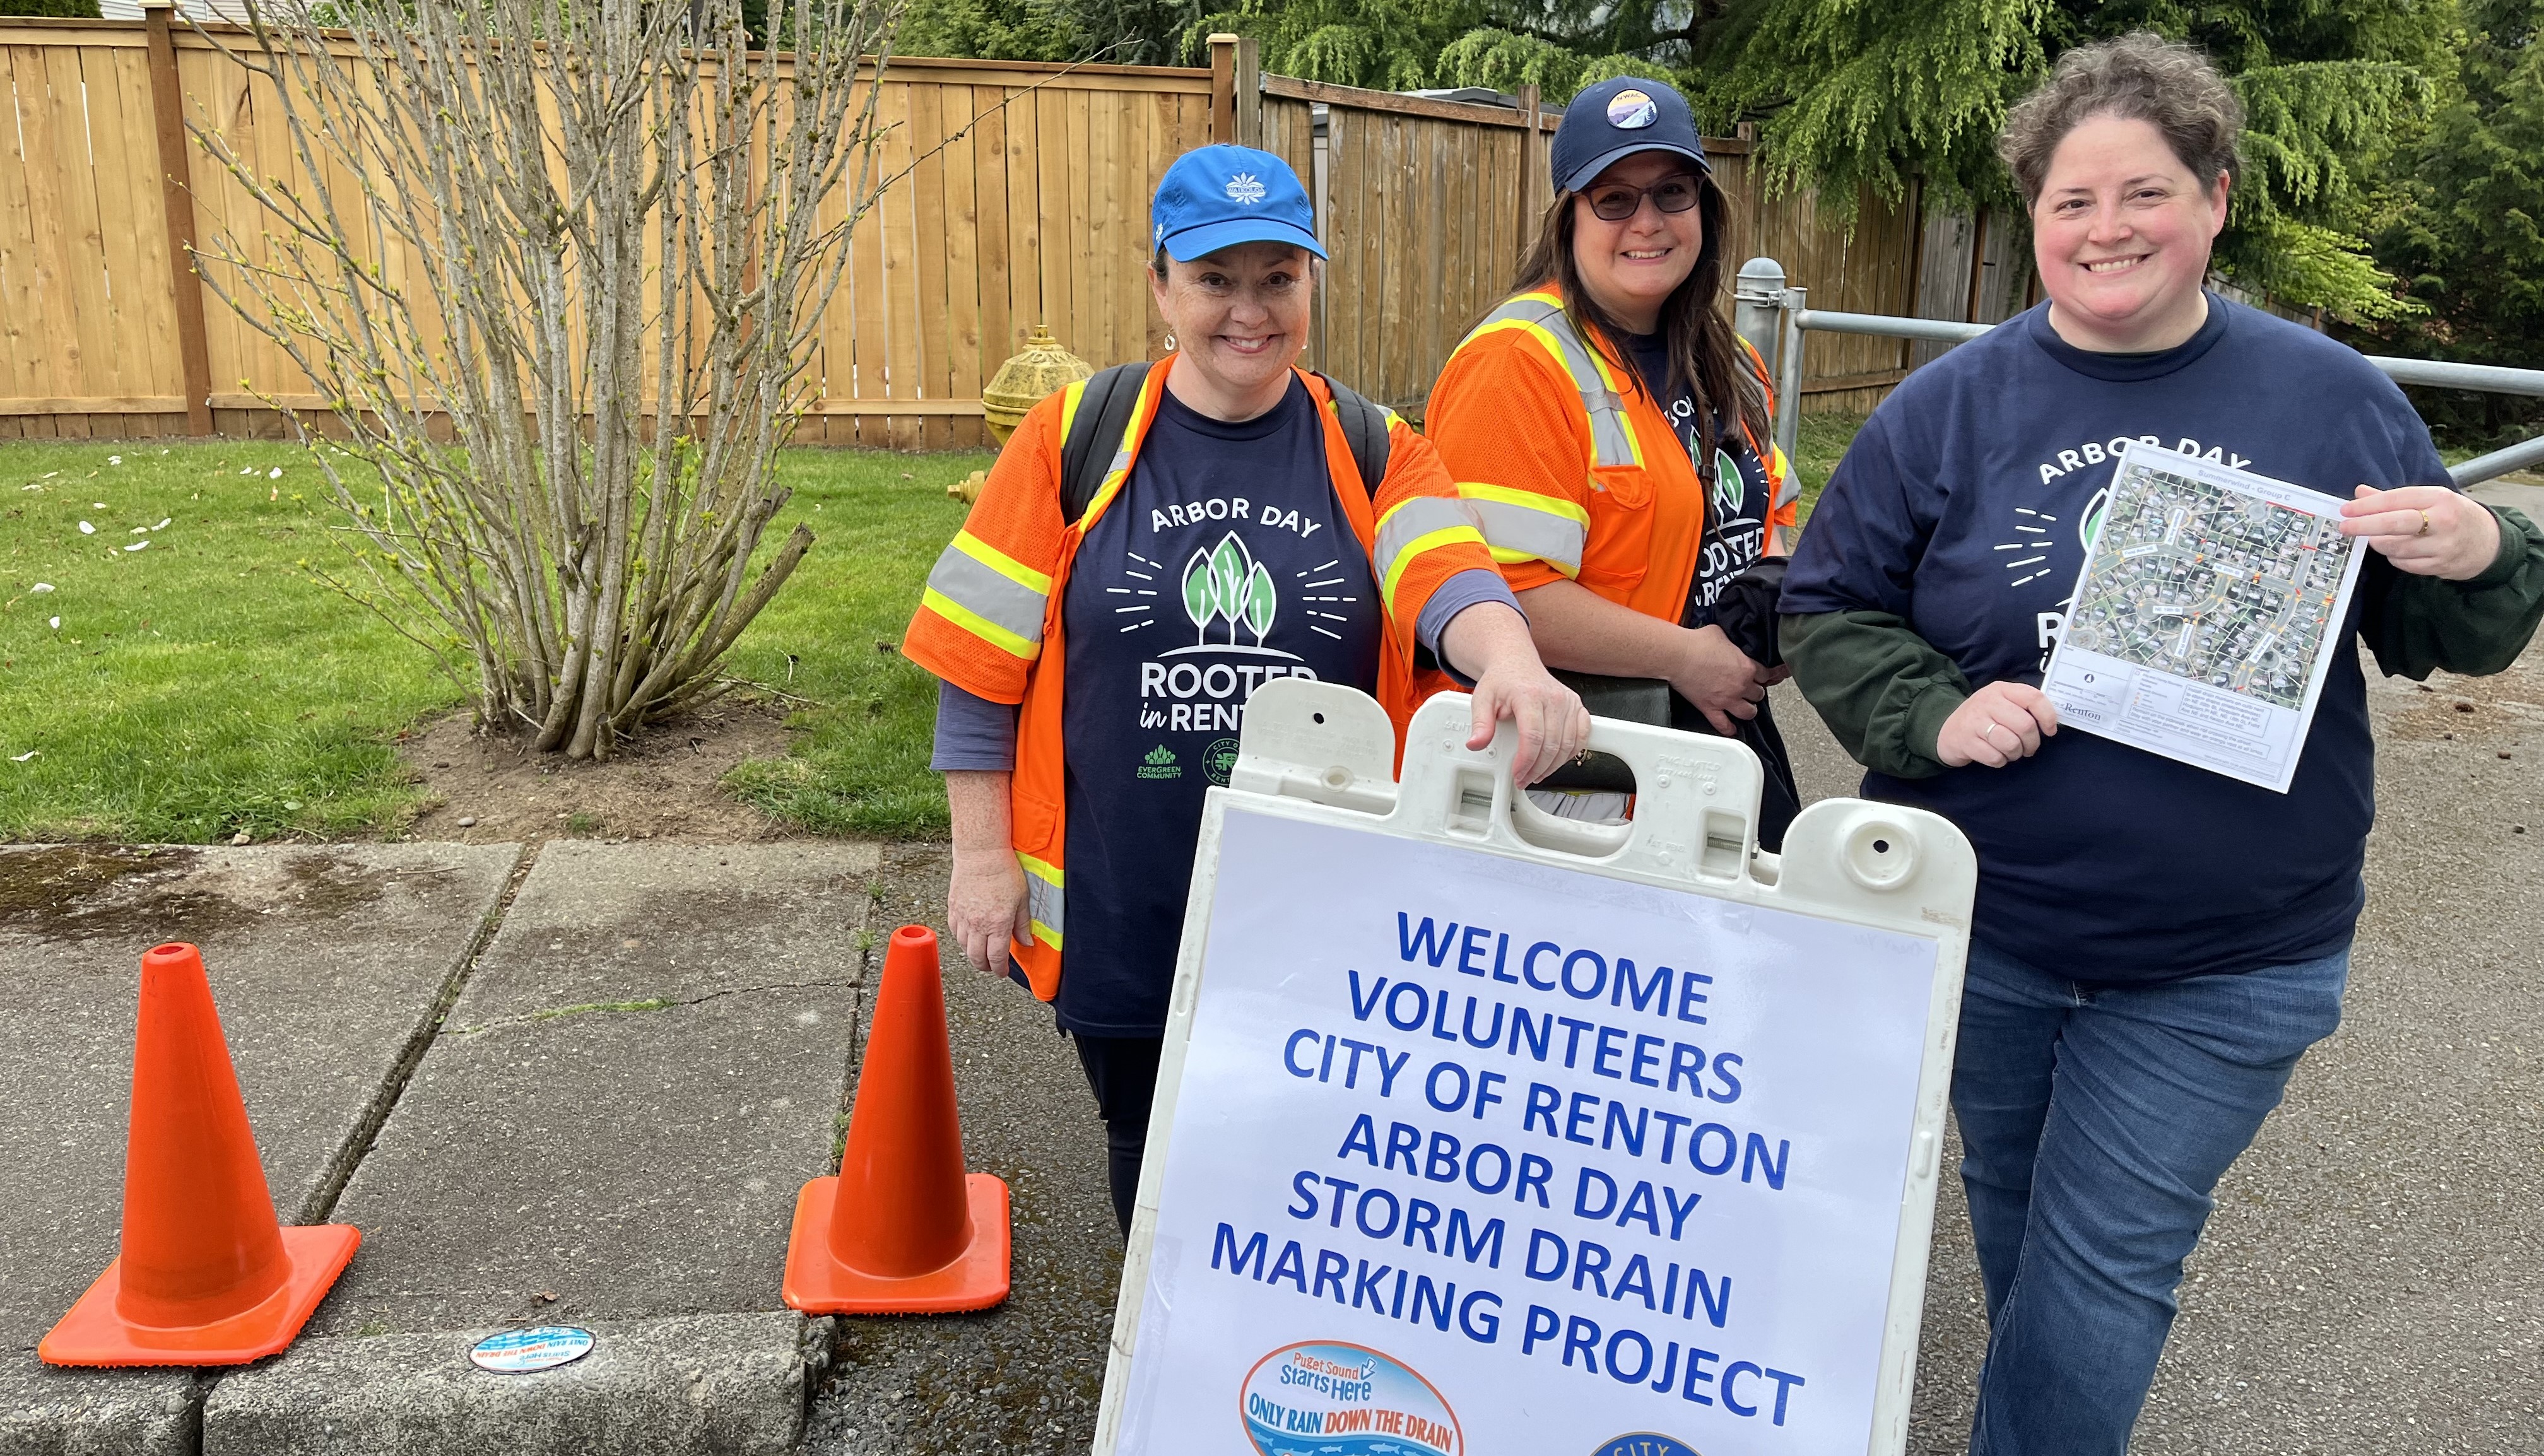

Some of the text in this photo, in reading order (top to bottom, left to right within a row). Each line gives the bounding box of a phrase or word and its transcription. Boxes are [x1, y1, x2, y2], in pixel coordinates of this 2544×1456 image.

[2198, 469, 2251, 490] Summerwind
[2257, 487, 2282, 499] Group
[1151, 497, 1322, 539] ARBOR DAY
[1140, 702, 1167, 729] in
[1444, 720, 1471, 734] SENT
[2064, 702, 2101, 721] Renton
[1213, 741, 1229, 750] CITY
[1398, 912, 1713, 1025] WELCOME
[1348, 970, 1743, 1104] VOLUNTEERS
[1284, 1028, 1790, 1190] CITY OF RENTON
[1337, 1113, 1702, 1241] ARBOR DAY
[1288, 1170, 1732, 1329] STORM DRAIN
[1211, 1222, 1805, 1426] MARKING PROJECT
[519, 1343, 545, 1354] DOWN
[1293, 1352, 1359, 1380] Puget Sound
[1281, 1365, 1371, 1401] Starts Here
[1249, 1393, 1453, 1453] ONLY RAIN DOWN THE DRAIN
